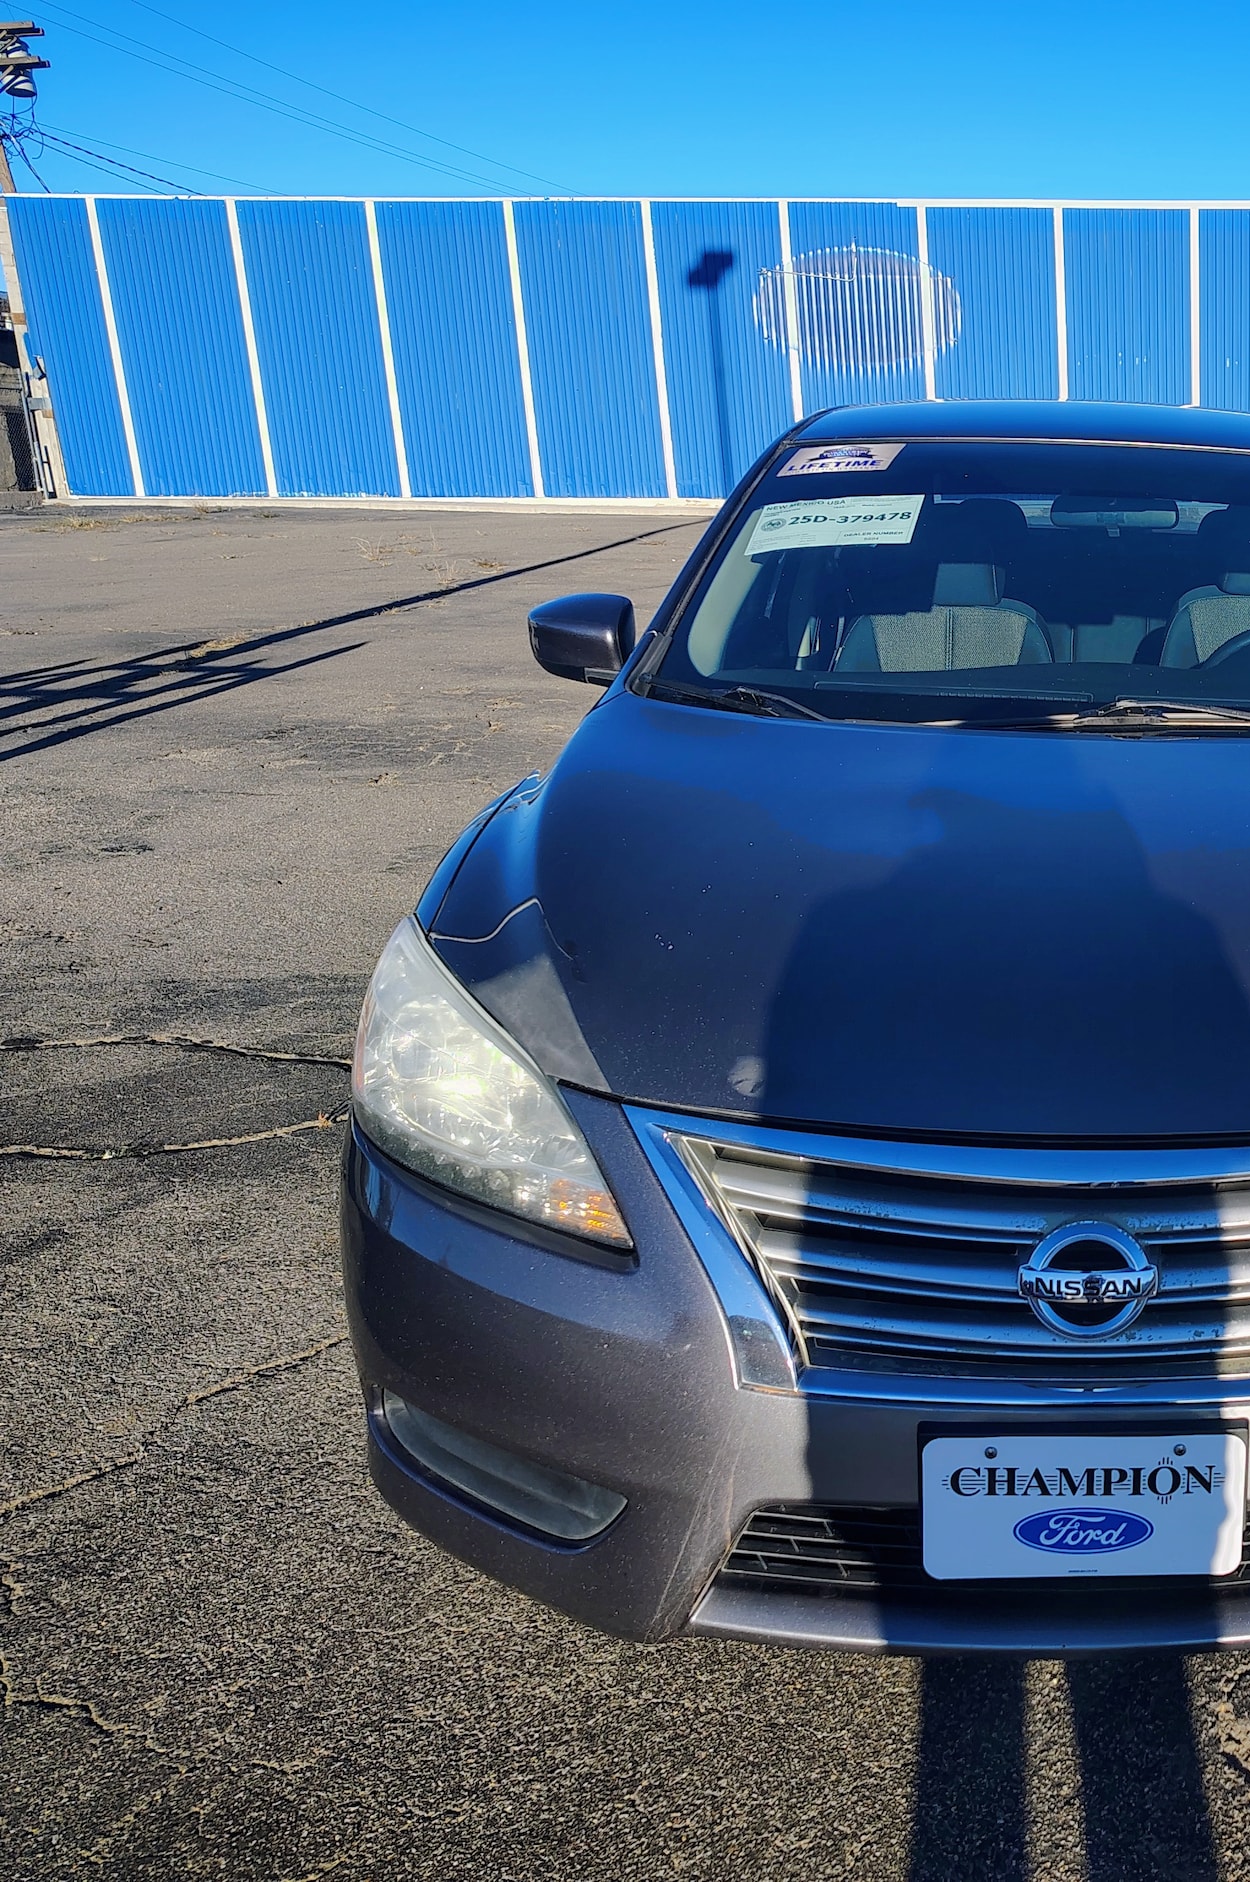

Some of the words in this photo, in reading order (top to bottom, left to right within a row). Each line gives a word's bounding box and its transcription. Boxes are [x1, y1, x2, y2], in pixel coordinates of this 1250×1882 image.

[787, 460, 883, 472] LIFETIME
[789, 500, 825, 508] MEXICO
[788, 511, 912, 526] 25D-379478
[1034, 1277, 1141, 1297] NISSAN
[950, 1465, 1216, 1498] CHAMPION
[1039, 1513, 1128, 1547] Ford
